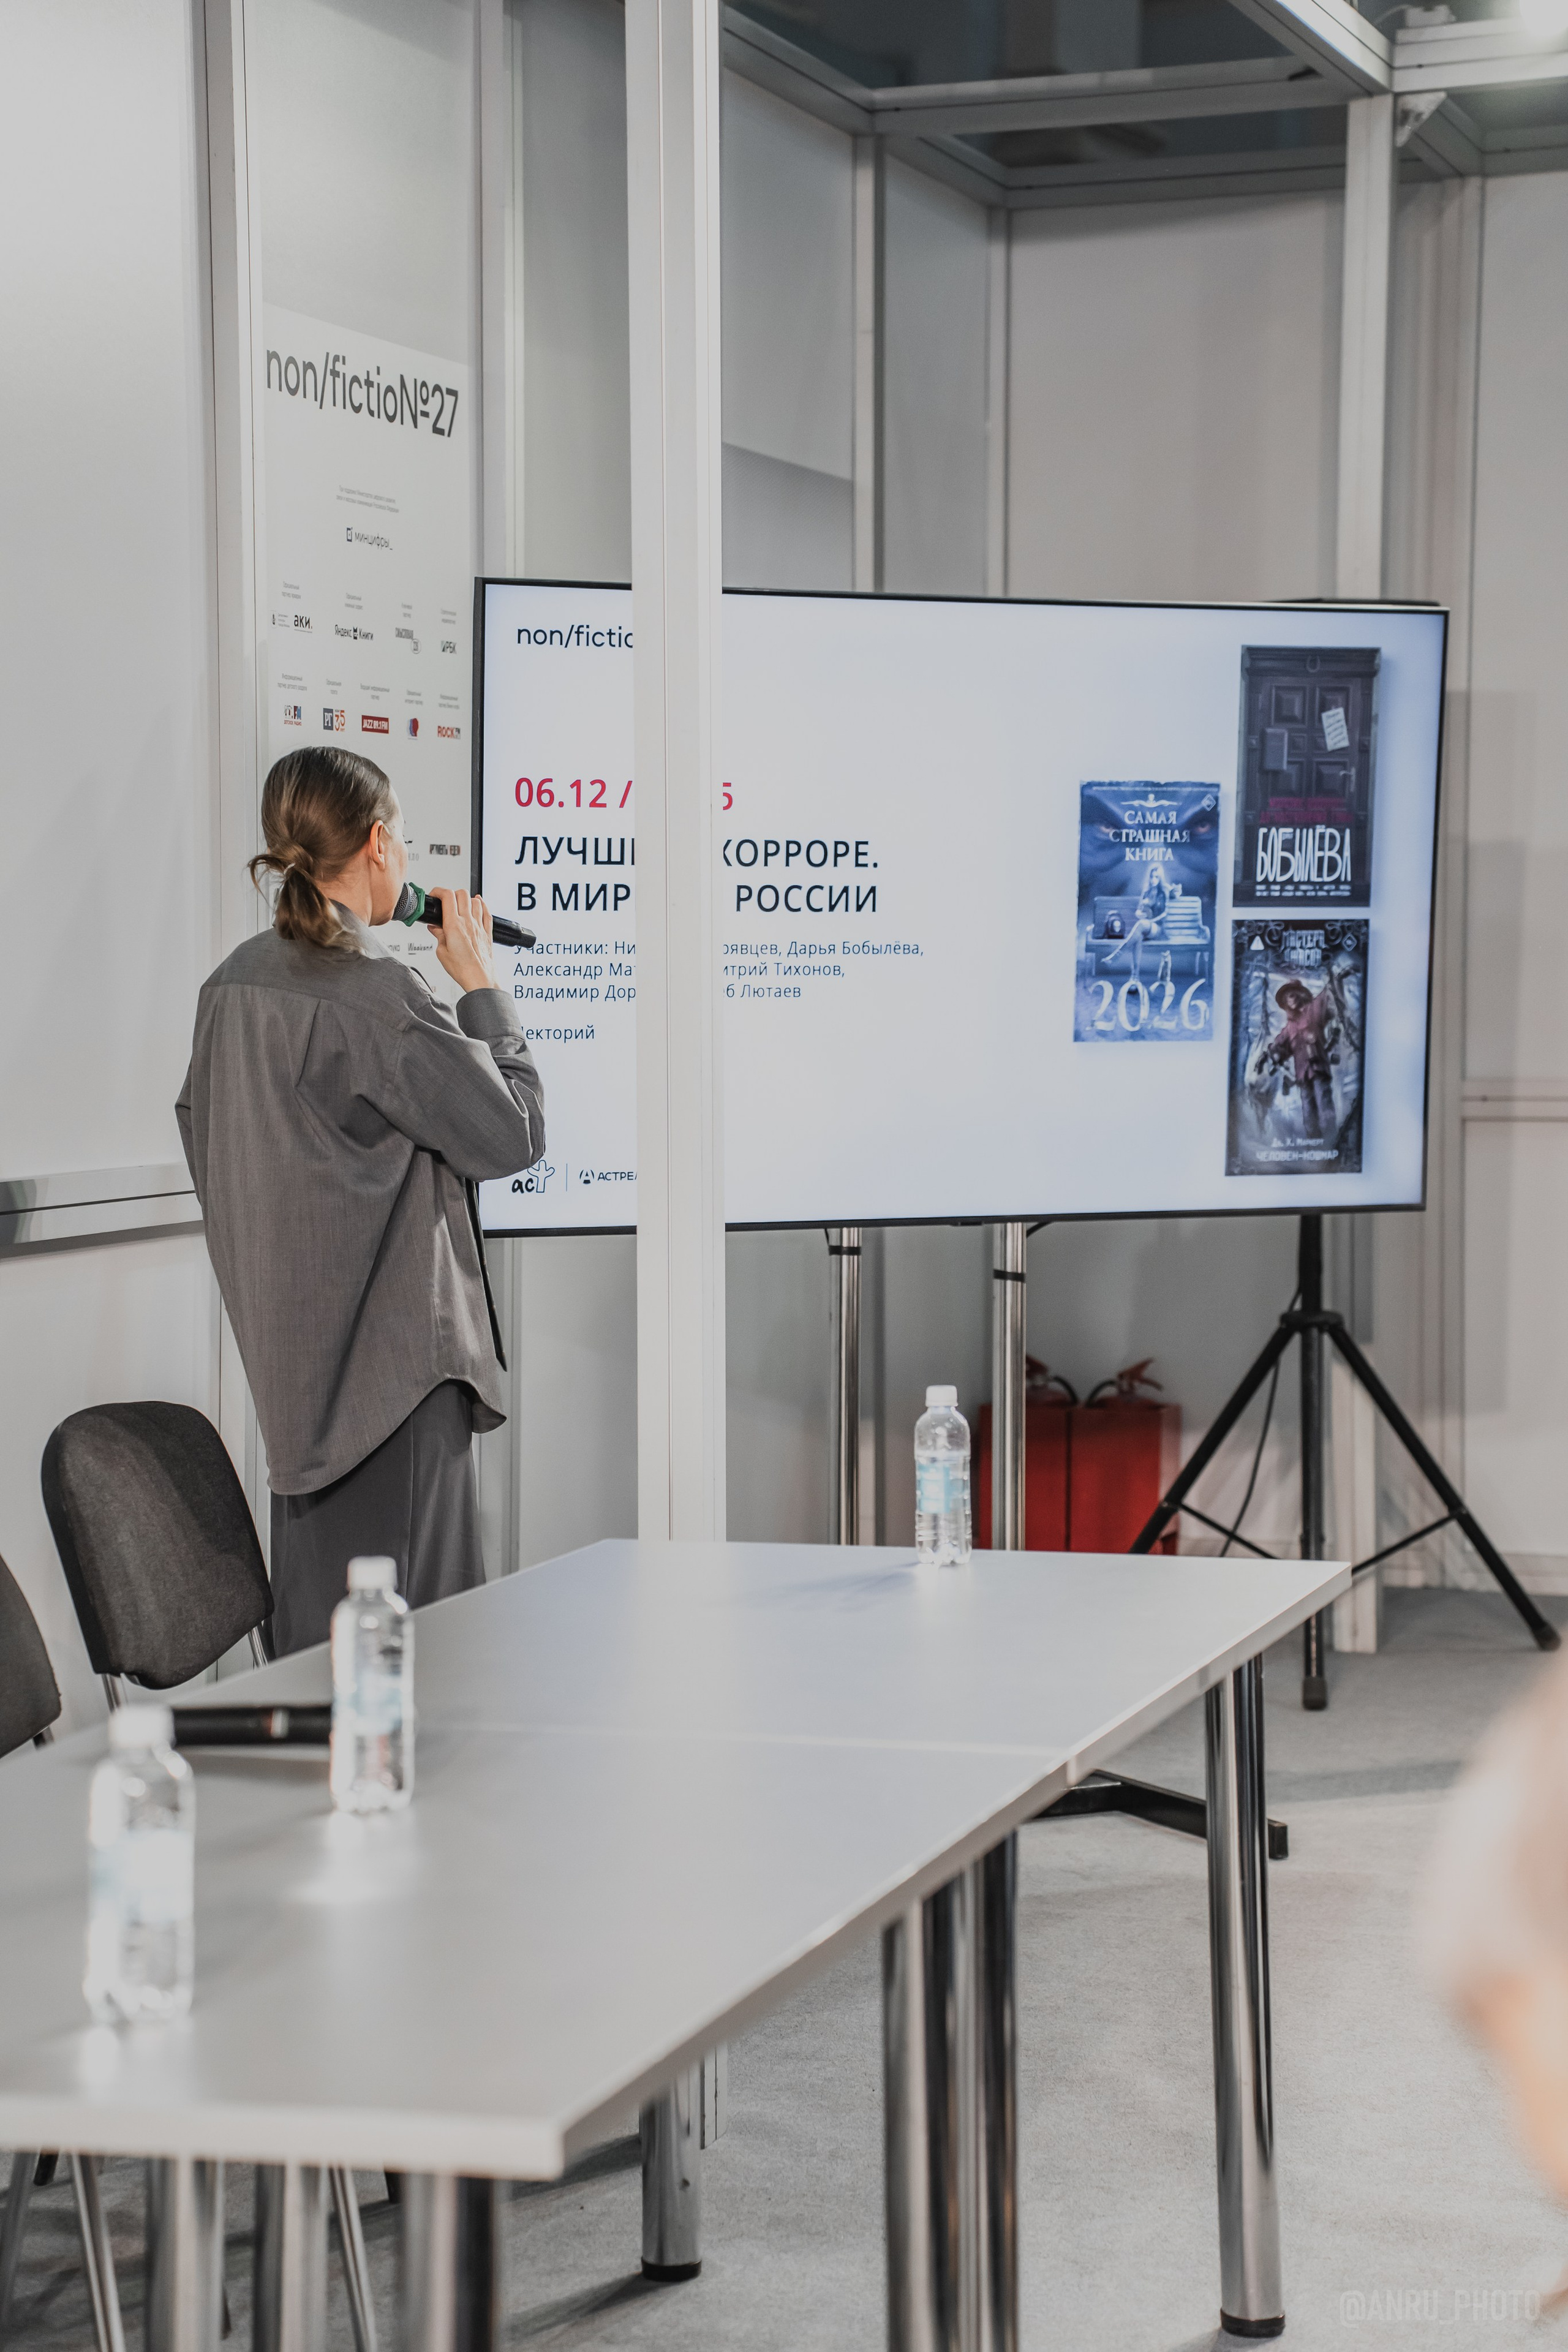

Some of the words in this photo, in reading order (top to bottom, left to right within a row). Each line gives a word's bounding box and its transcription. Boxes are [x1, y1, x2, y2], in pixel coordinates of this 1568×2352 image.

[362, 719, 373, 729] JAZZ
[515, 777, 607, 808] 06.12
[1123, 810, 1177, 824] САМАЯ
[1109, 829, 1190, 843] СТРАШНАЯ
[514, 836, 635, 865] ЛУЧШ
[1125, 847, 1174, 861] КНИГА
[518, 883, 537, 911] В
[552, 883, 631, 911] МИР
[736, 884, 876, 913] РОССИИ
[787, 942, 836, 958] Дарья
[842, 941, 924, 957] Бобылёва,
[513, 963, 603, 979] Александр
[774, 963, 845, 978] Тихонов,
[514, 985, 600, 1001] Владимир
[740, 985, 801, 998] Лютаев
[1085, 978, 1210, 1032] 2026
[521, 1025, 595, 1043] екторий
